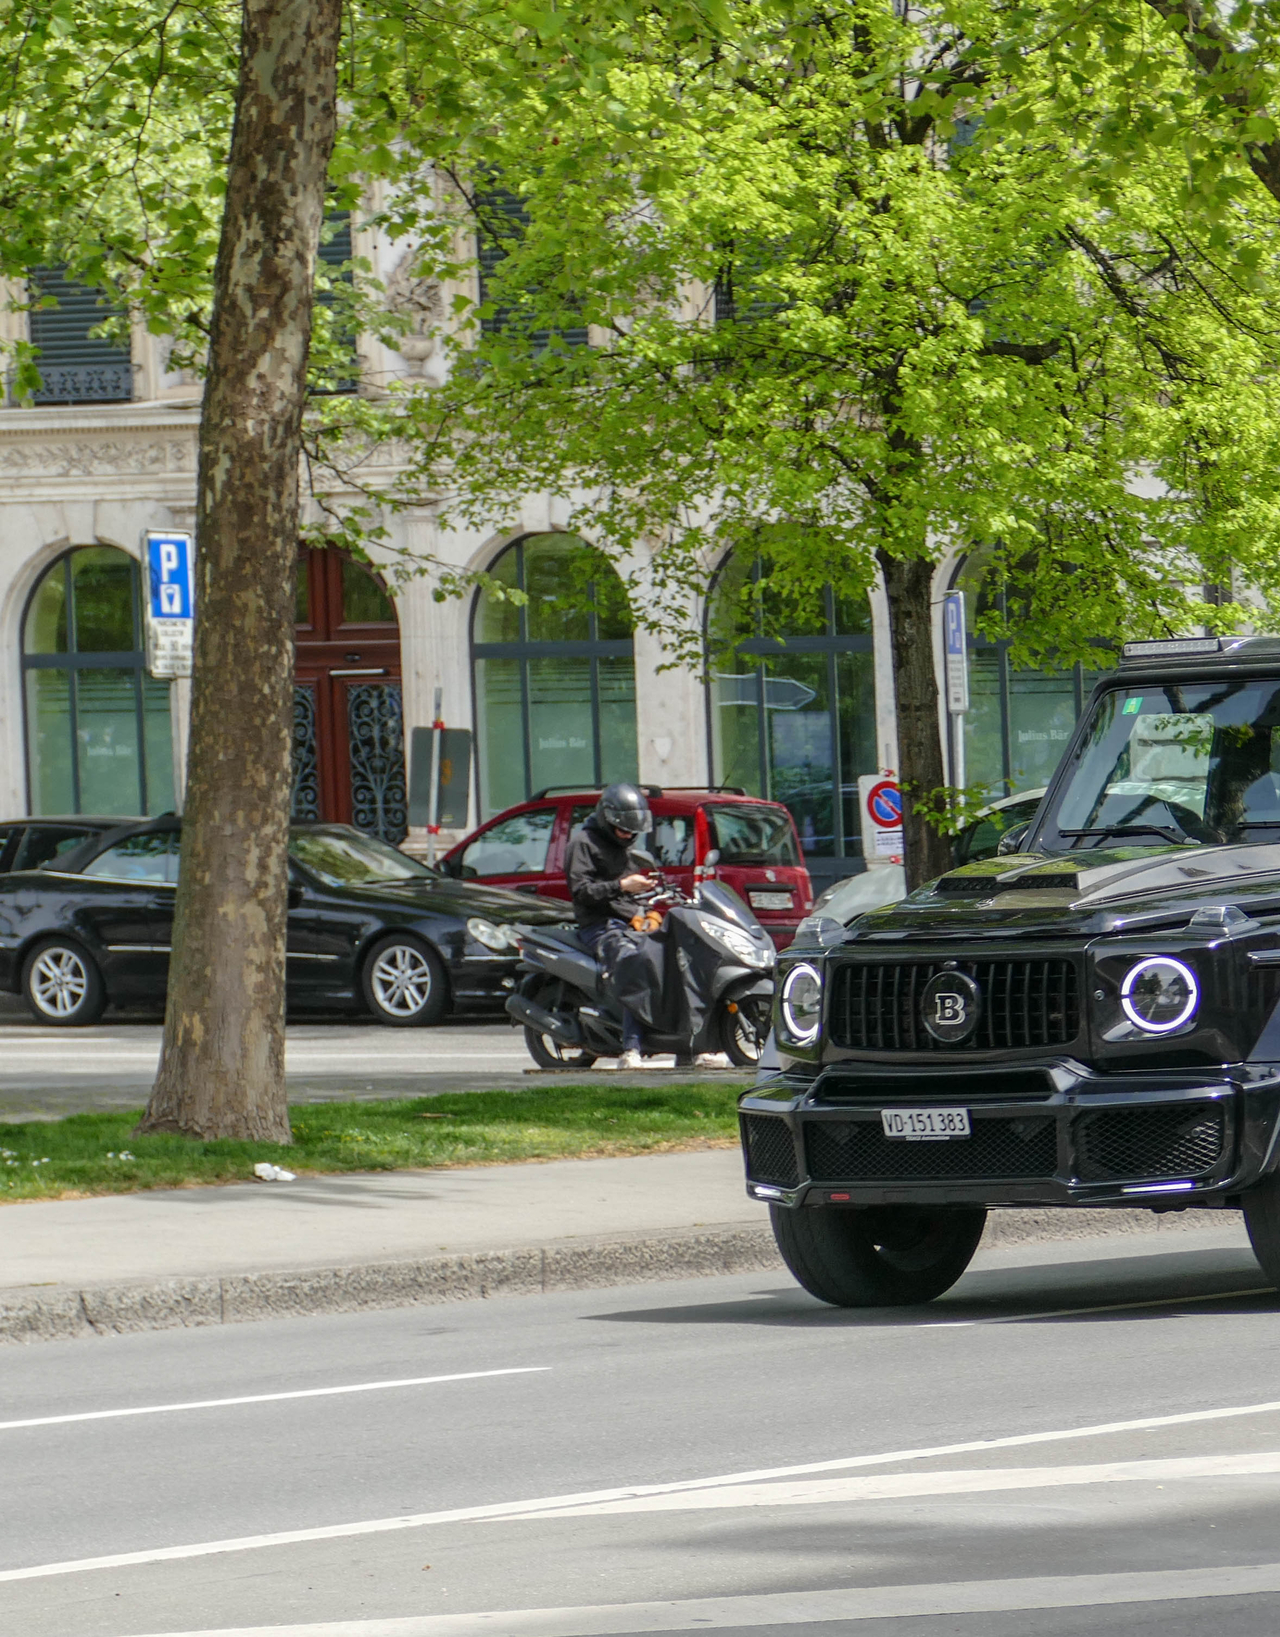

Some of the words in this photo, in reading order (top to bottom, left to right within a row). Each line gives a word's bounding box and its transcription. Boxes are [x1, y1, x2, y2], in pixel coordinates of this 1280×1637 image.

[160, 543, 178, 583] P
[948, 602, 958, 646] P
[1018, 730, 1048, 743] Julius
[935, 993, 966, 1025] B
